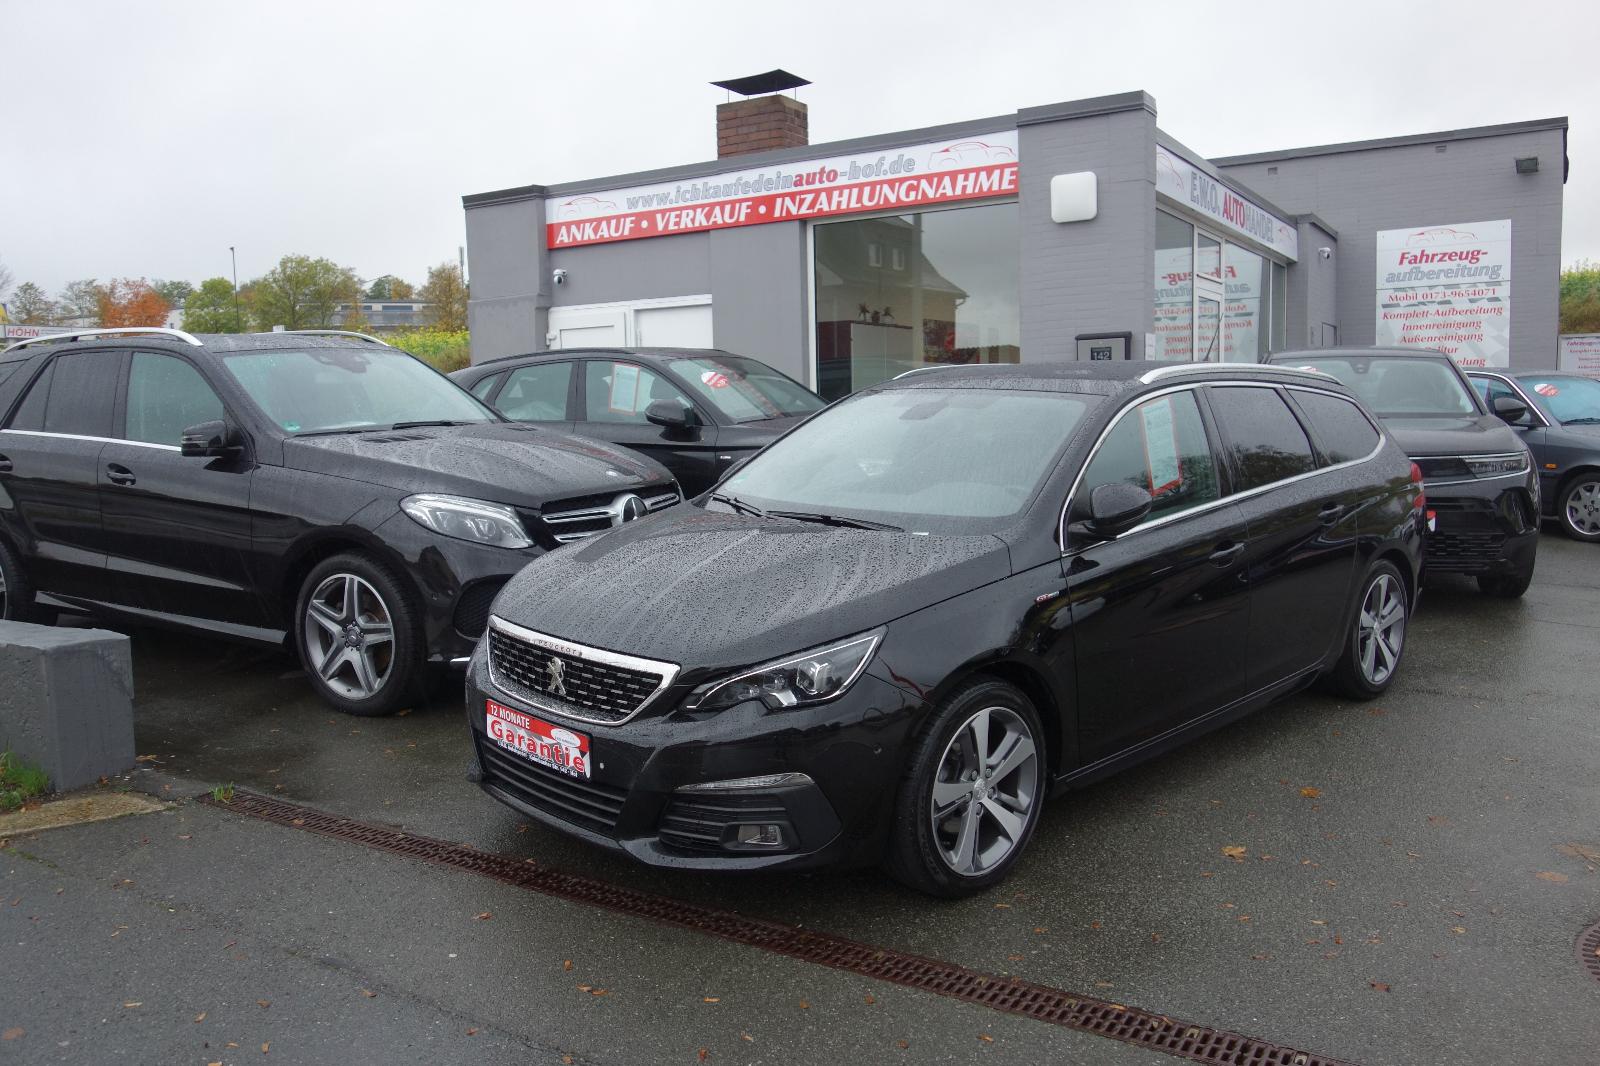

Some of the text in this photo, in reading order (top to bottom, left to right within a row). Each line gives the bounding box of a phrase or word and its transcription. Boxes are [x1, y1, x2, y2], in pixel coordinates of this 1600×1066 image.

[626, 153, 916, 210] www.ichkaufedeinauto-hof.de
[556, 167, 1018, 244] ANKAUF VERKAUF INZAHLUNGNAHME
[1398, 248, 1489, 266] Fahrzeug-
[1385, 264, 1503, 283] aufbereitung
[1388, 293, 1418, 303] Mobil
[1382, 306, 1503, 321] Komplett-Aufbereitung
[1402, 320, 1482, 331] Innenreinigung
[1400, 332, 1483, 344] Außenreinigung
[490, 704, 530, 729] 12 MONATE
[490, 719, 585, 773] Garantie
